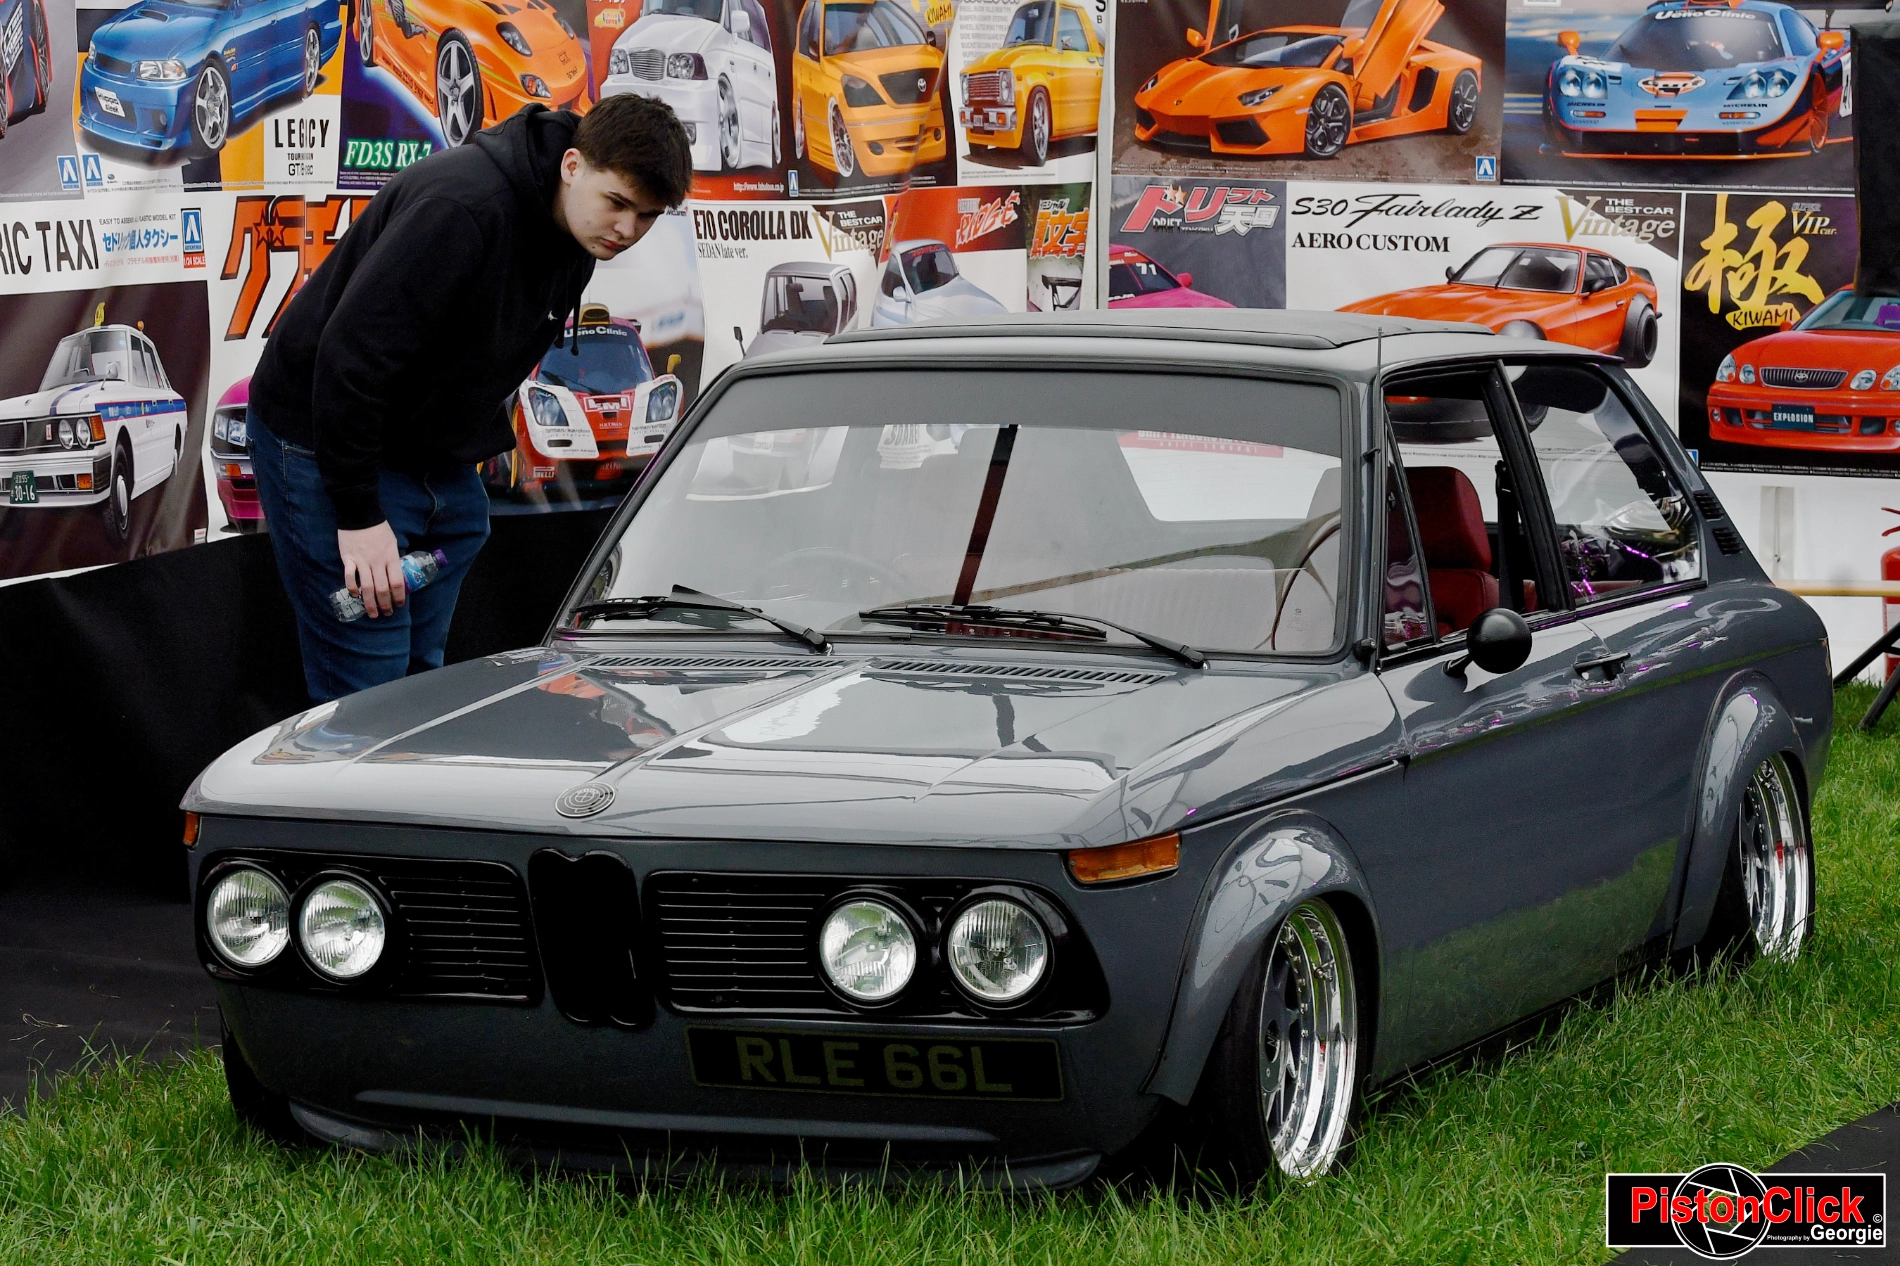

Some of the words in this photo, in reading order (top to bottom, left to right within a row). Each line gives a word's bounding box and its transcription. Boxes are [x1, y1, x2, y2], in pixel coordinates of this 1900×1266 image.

[344, 141, 393, 167] FD3S
[395, 142, 432, 167] RX-7
[837, 209, 857, 219] THE
[1291, 197, 1349, 216] S30
[1343, 193, 1505, 228] Fairlady
[1508, 205, 1544, 220] Z
[1605, 197, 1634, 207] THE
[1605, 205, 1643, 214] BEST
[1643, 206, 1674, 216] CAR
[718, 209, 787, 240] COROLLA
[790, 209, 812, 239] DX
[839, 217, 864, 227] BEST
[864, 215, 883, 225] CAR
[1555, 195, 1676, 244] Vintage
[1792, 211, 1831, 235] VIP
[35, 219, 100, 272] TAXI
[812, 211, 884, 261] Vintage
[1291, 231, 1352, 250] AERO
[1355, 233, 1450, 253] CUSTOM
[1685, 193, 1826, 314] 極
[1731, 307, 1795, 328] KIWAMI
[596, 326, 628, 337] Clinic
[1773, 411, 1814, 424] EXPLOSION
[735, 1036, 865, 1087] RLE
[882, 1044, 1013, 1093] 66L
